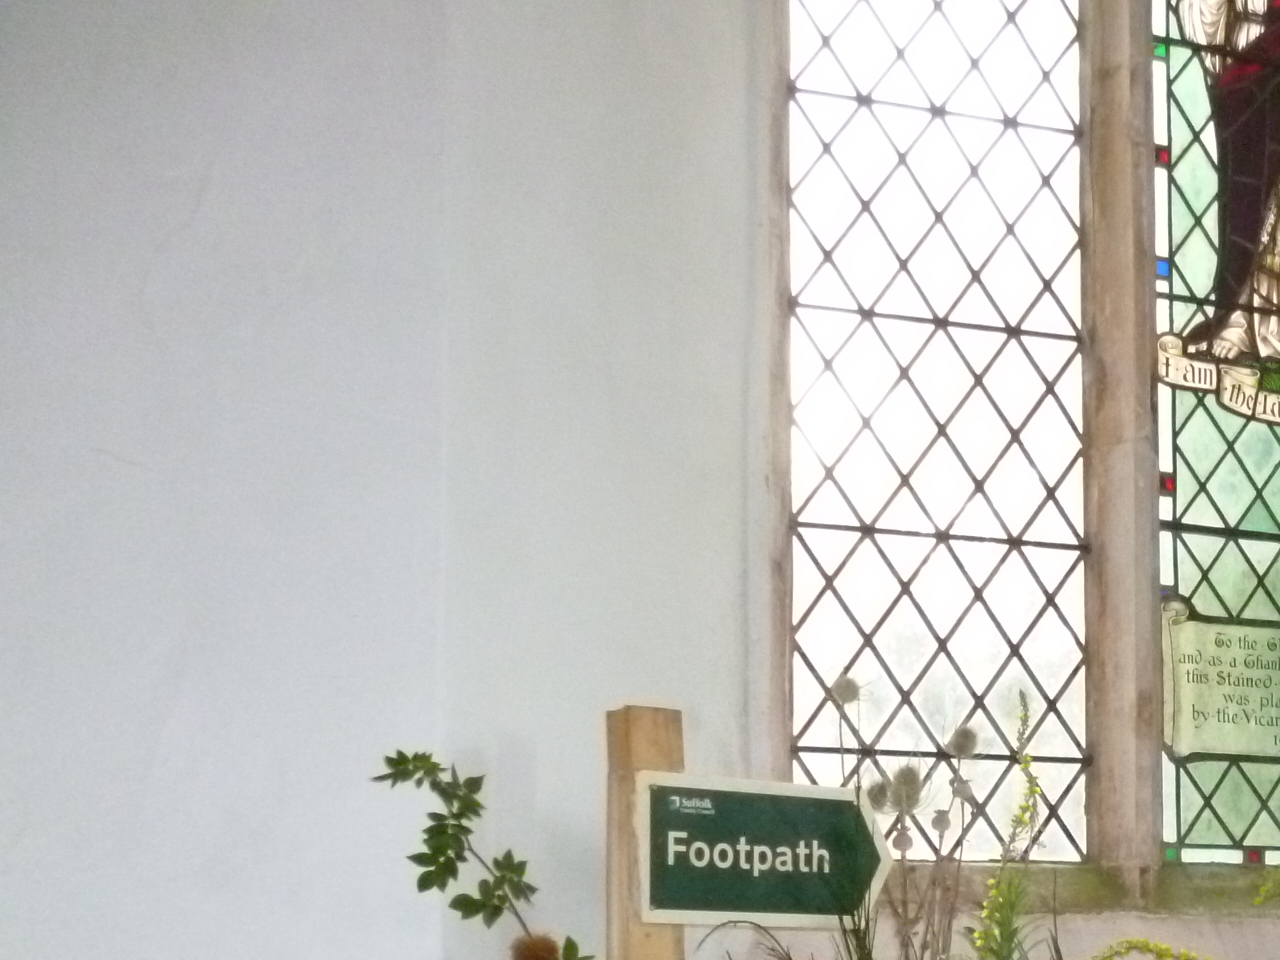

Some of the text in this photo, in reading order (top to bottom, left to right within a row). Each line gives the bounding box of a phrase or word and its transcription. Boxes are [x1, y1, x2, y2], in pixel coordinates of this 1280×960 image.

[1183, 363, 1213, 387] am
[1229, 384, 1255, 411] the
[1214, 633, 1233, 649] To
[1238, 635, 1258, 652] the
[1179, 651, 1203, 664] and
[1208, 655, 1223, 666] as
[1229, 656, 1238, 668] a
[1185, 670, 1210, 685] this
[1216, 670, 1272, 689] Stained
[1223, 692, 1250, 706] was
[1192, 704, 1210, 729] by
[1216, 706, 1238, 725] the
[667, 831, 830, 877] Footpath
